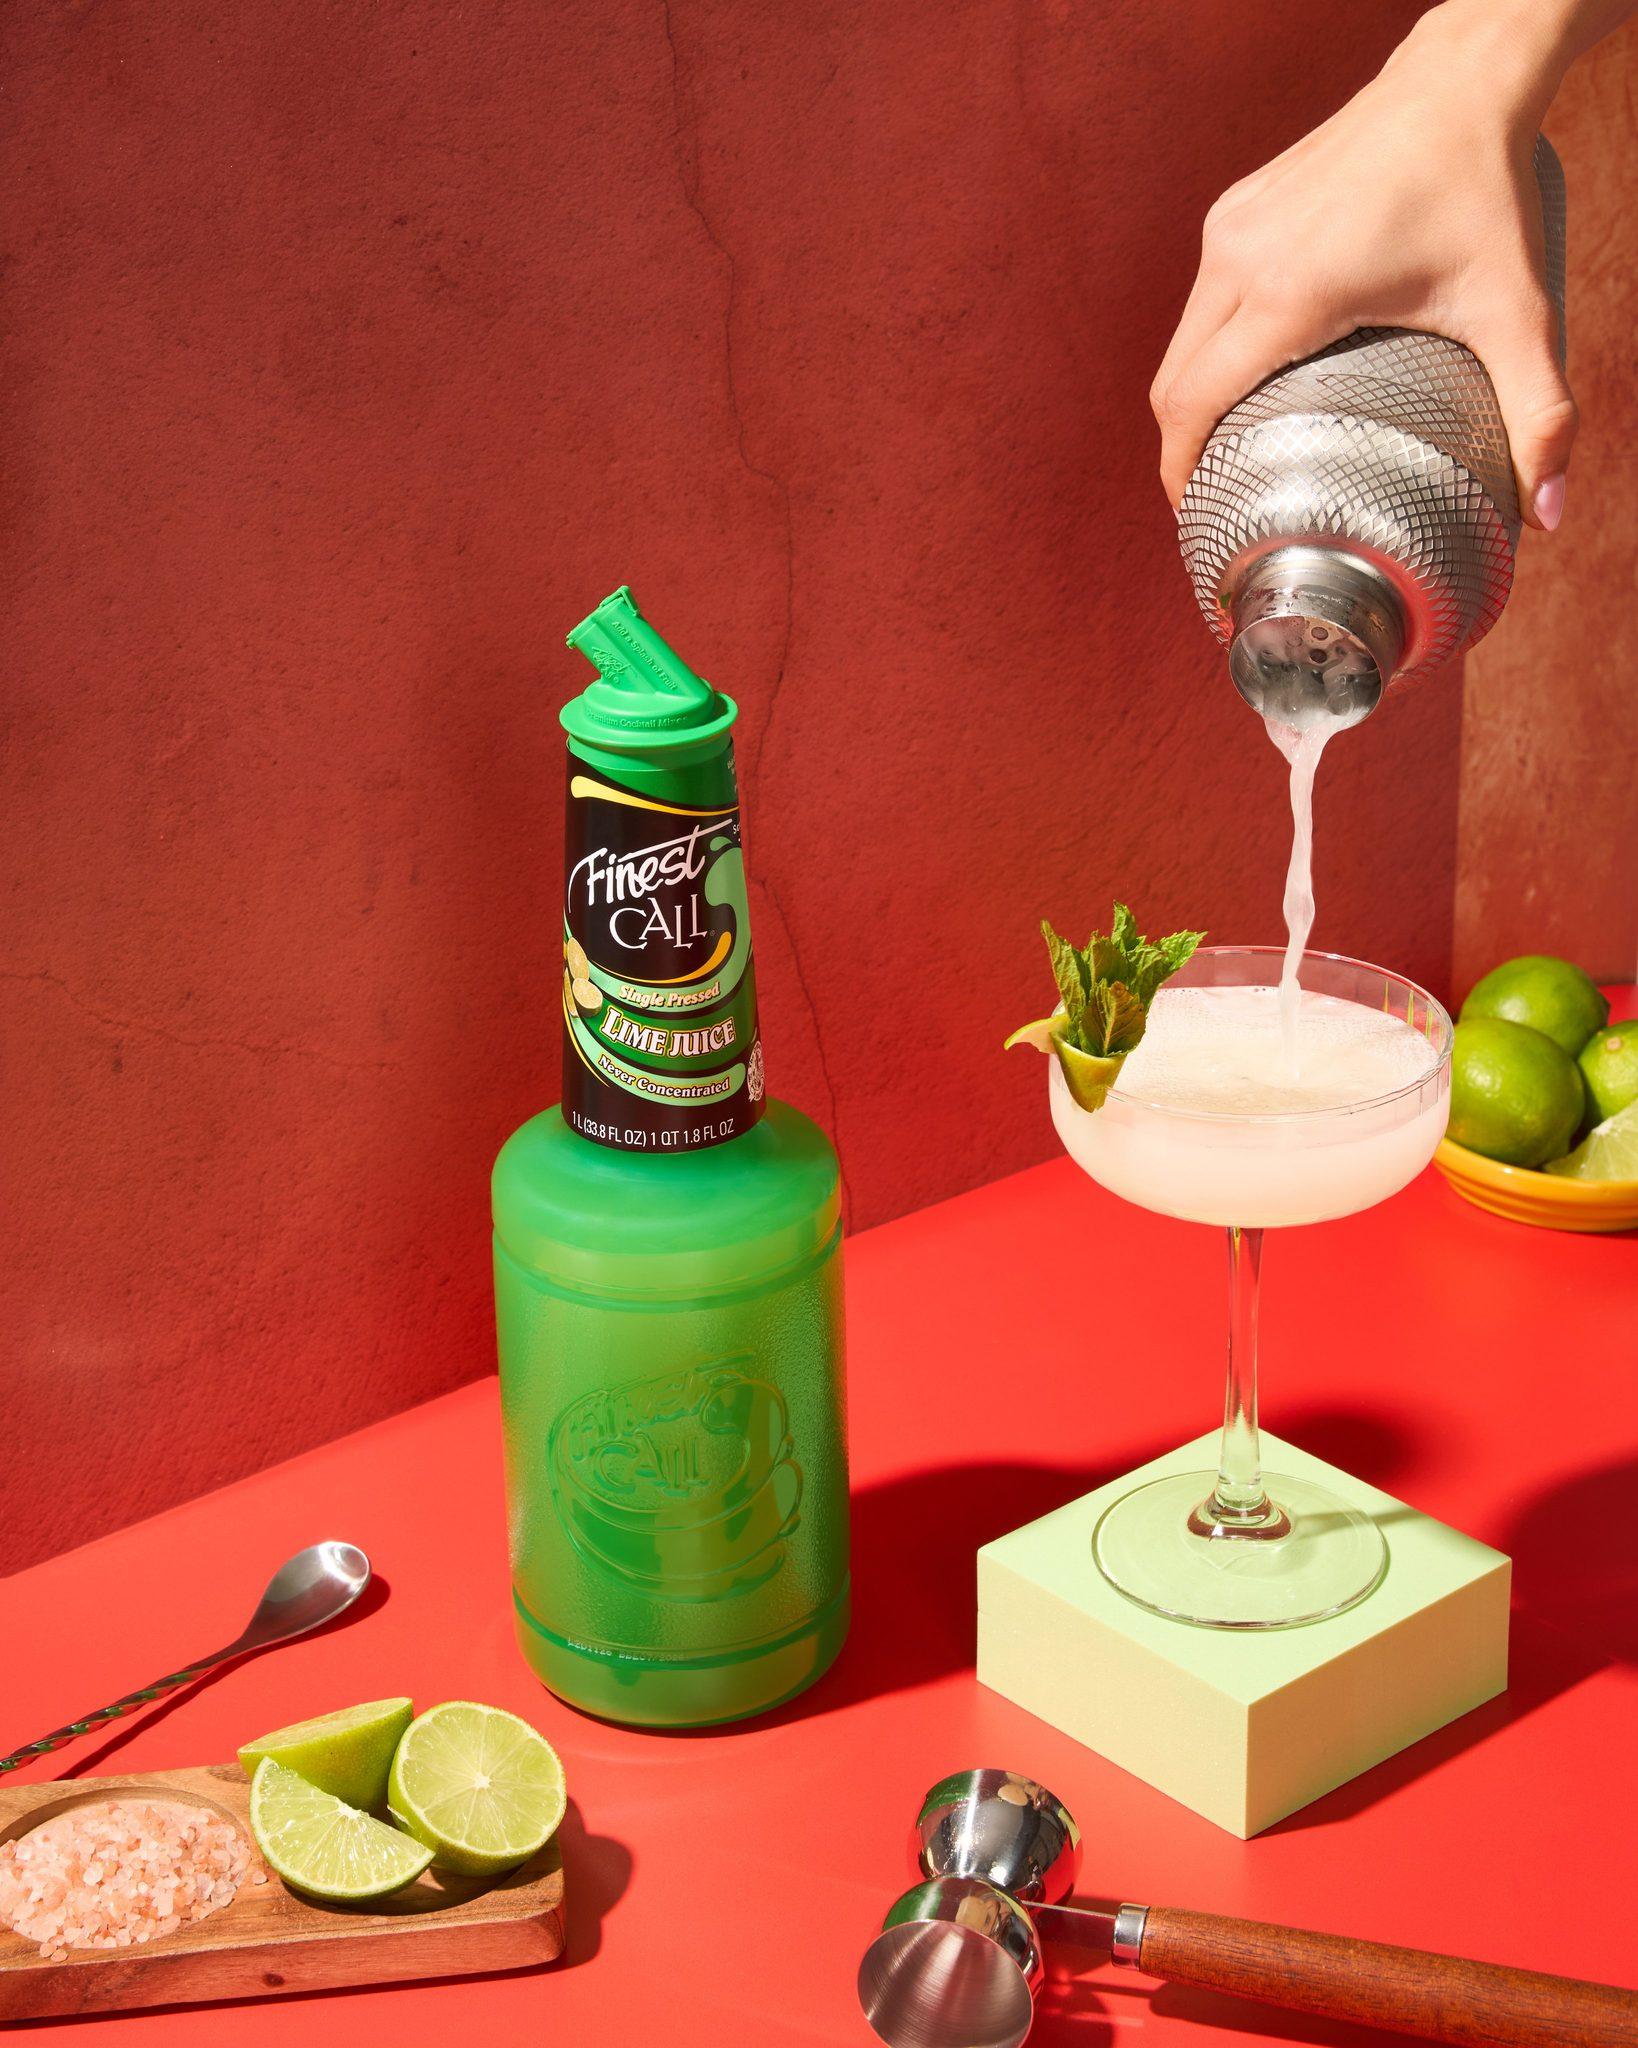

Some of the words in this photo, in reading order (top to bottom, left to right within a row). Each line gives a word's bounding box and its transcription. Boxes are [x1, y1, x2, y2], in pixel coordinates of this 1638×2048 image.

[612, 621, 630, 637] Add
[630, 641, 656, 666] Splash
[659, 672, 678, 690] Fruit
[567, 819, 733, 914] Finest
[609, 893, 708, 950] CALL
[618, 983, 665, 1008] Single
[667, 980, 721, 1008] Pressed
[600, 1006, 667, 1056] LIME
[668, 1016, 736, 1058] JUICE
[598, 1053, 636, 1086] Never
[636, 1076, 731, 1099] Concentrated
[608, 1126, 622, 1143] FL
[624, 1129, 646, 1147] OZ)
[650, 1132, 656, 1146] 1
[661, 1130, 680, 1146] QT
[683, 1128, 700, 1144] 1.8
[703, 1125, 717, 1141] FL
[719, 1118, 734, 1136] OZ
